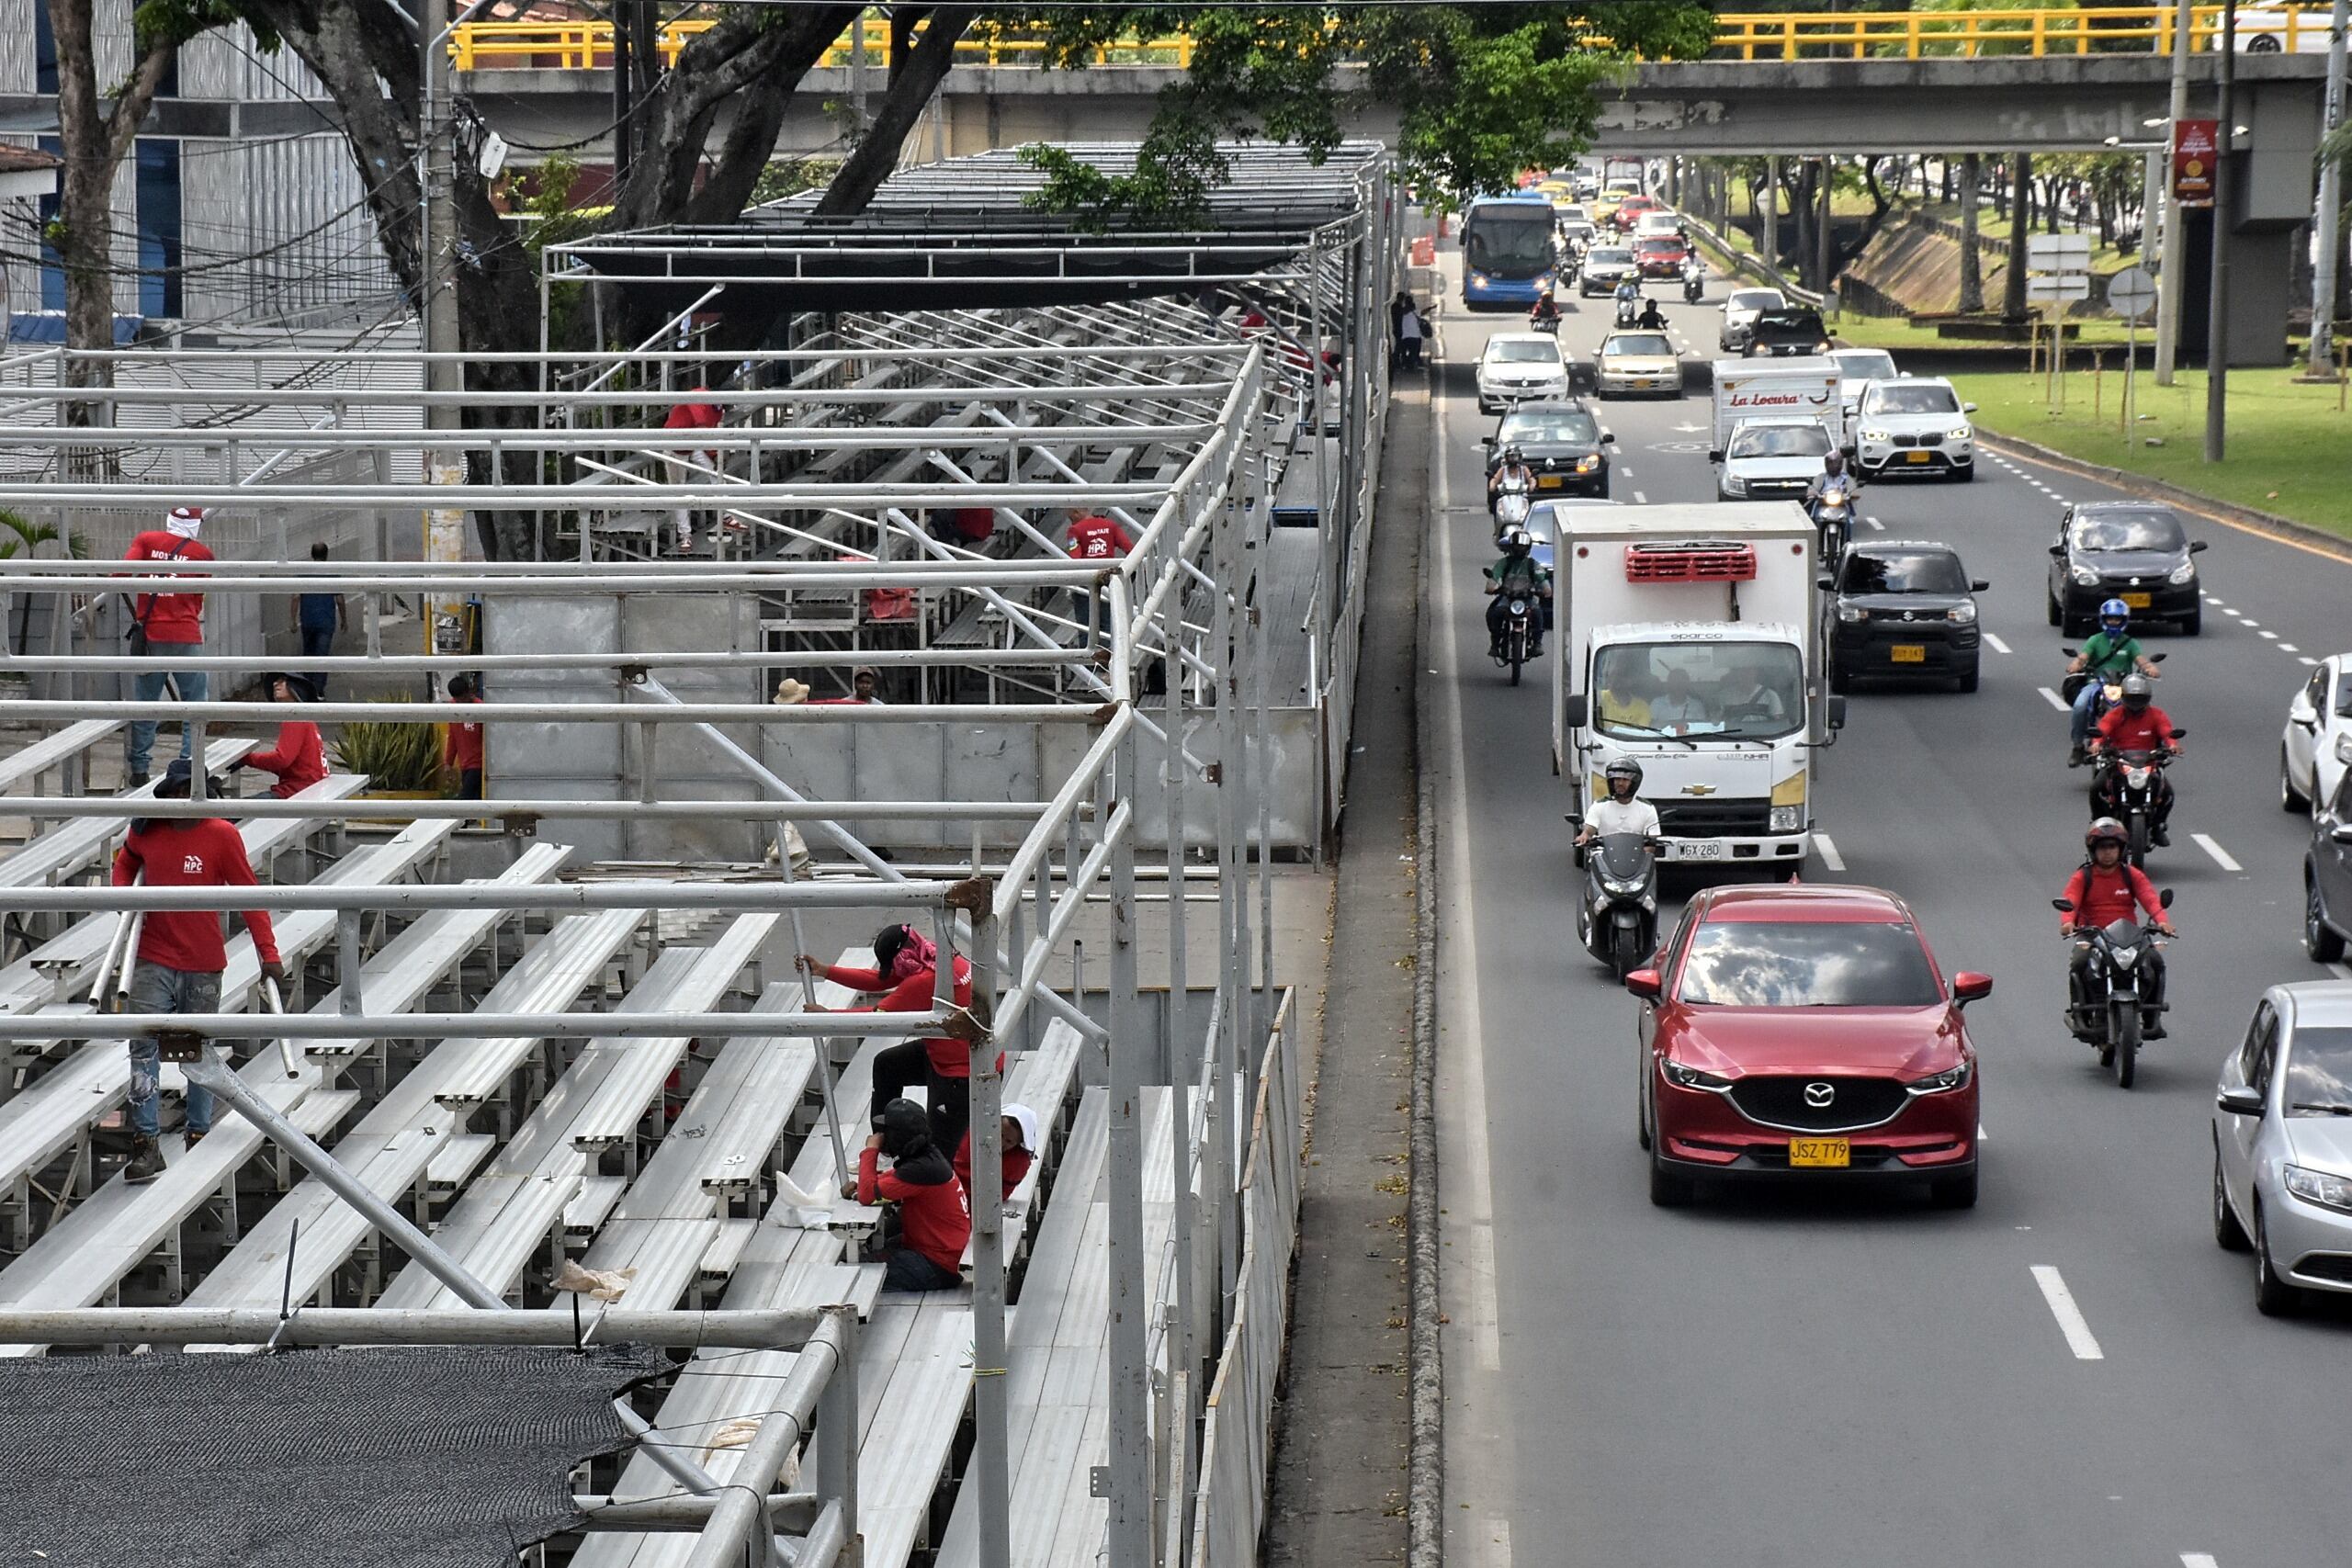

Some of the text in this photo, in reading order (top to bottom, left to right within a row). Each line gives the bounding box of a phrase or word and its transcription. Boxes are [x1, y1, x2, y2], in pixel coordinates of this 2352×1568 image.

[1730, 393, 1798, 406] La Locura
[1088, 543, 1107, 554] HPC
[1670, 632, 1724, 640] sparco
[184, 860, 203, 871] HPC
[1792, 1142, 1847, 1158] JSZ 779
